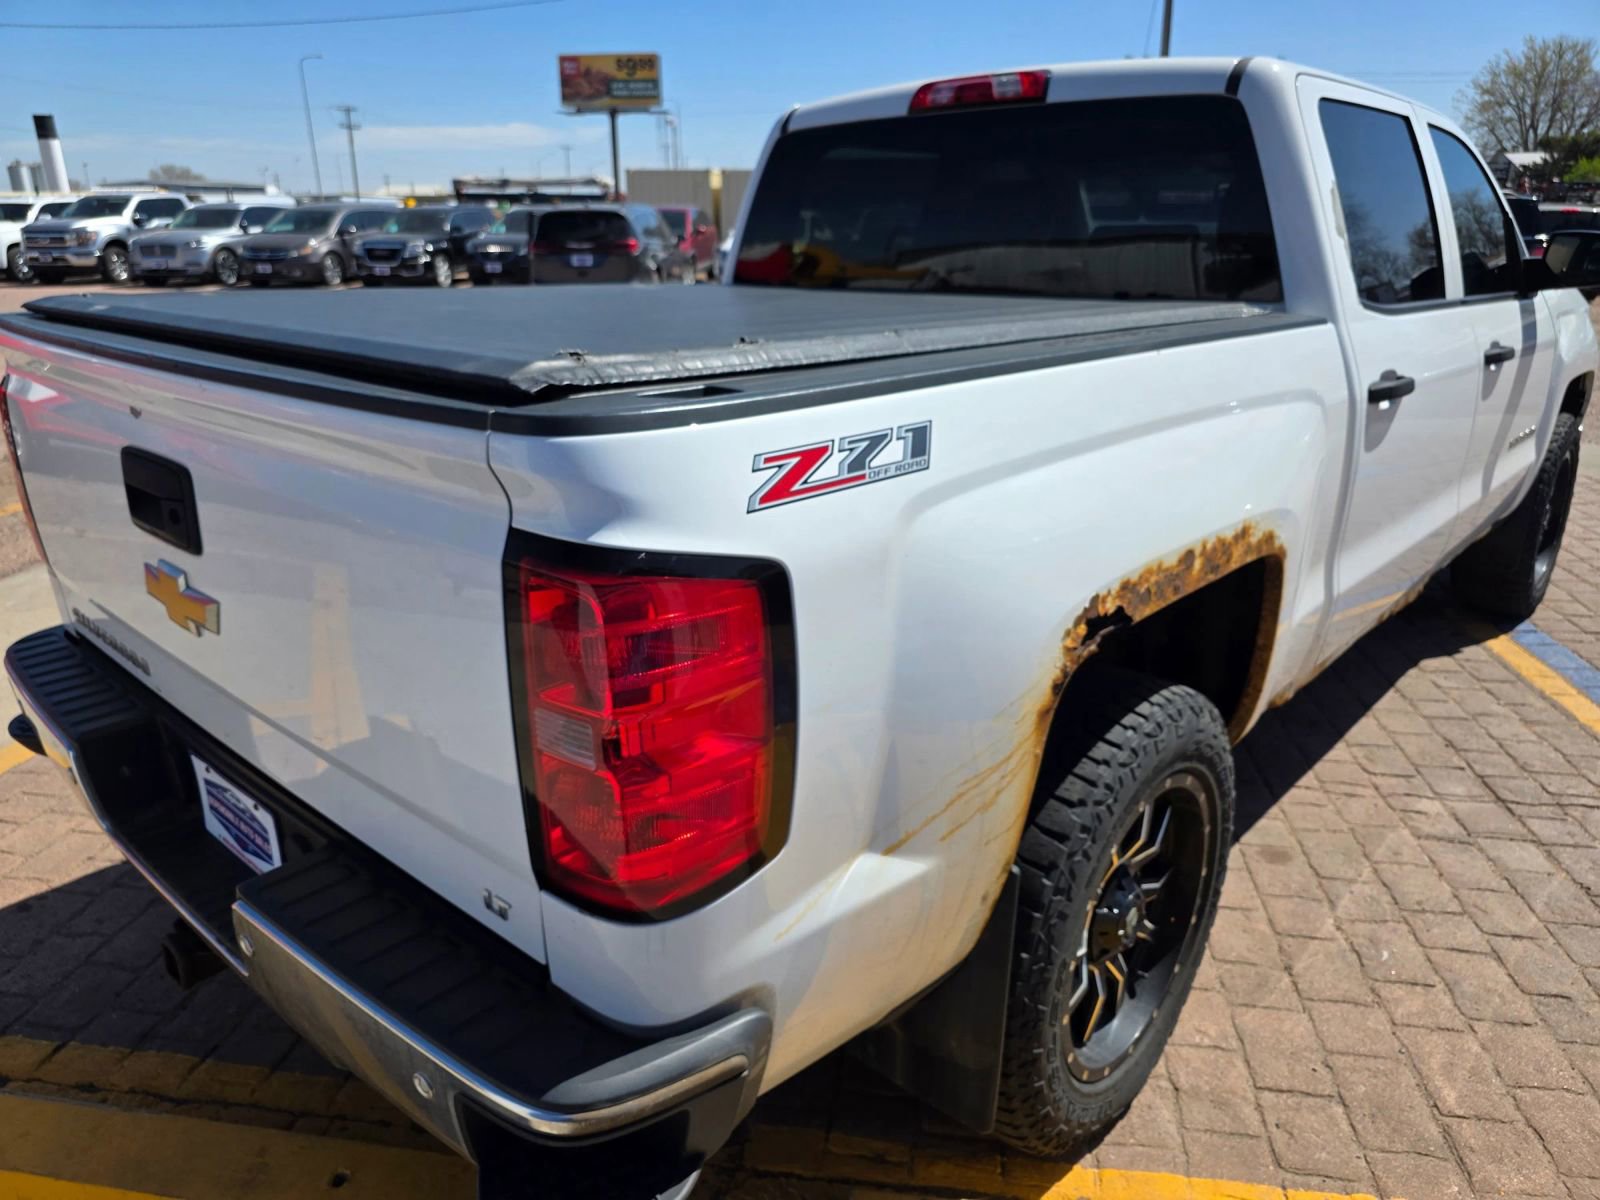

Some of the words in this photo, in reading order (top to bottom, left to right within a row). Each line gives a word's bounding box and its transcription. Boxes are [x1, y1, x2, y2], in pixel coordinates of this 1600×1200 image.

[747, 420, 932, 514] Z71
[868, 465, 892, 479] OFF
[894, 457, 927, 474] ROAD
[484, 888, 511, 921] LT
